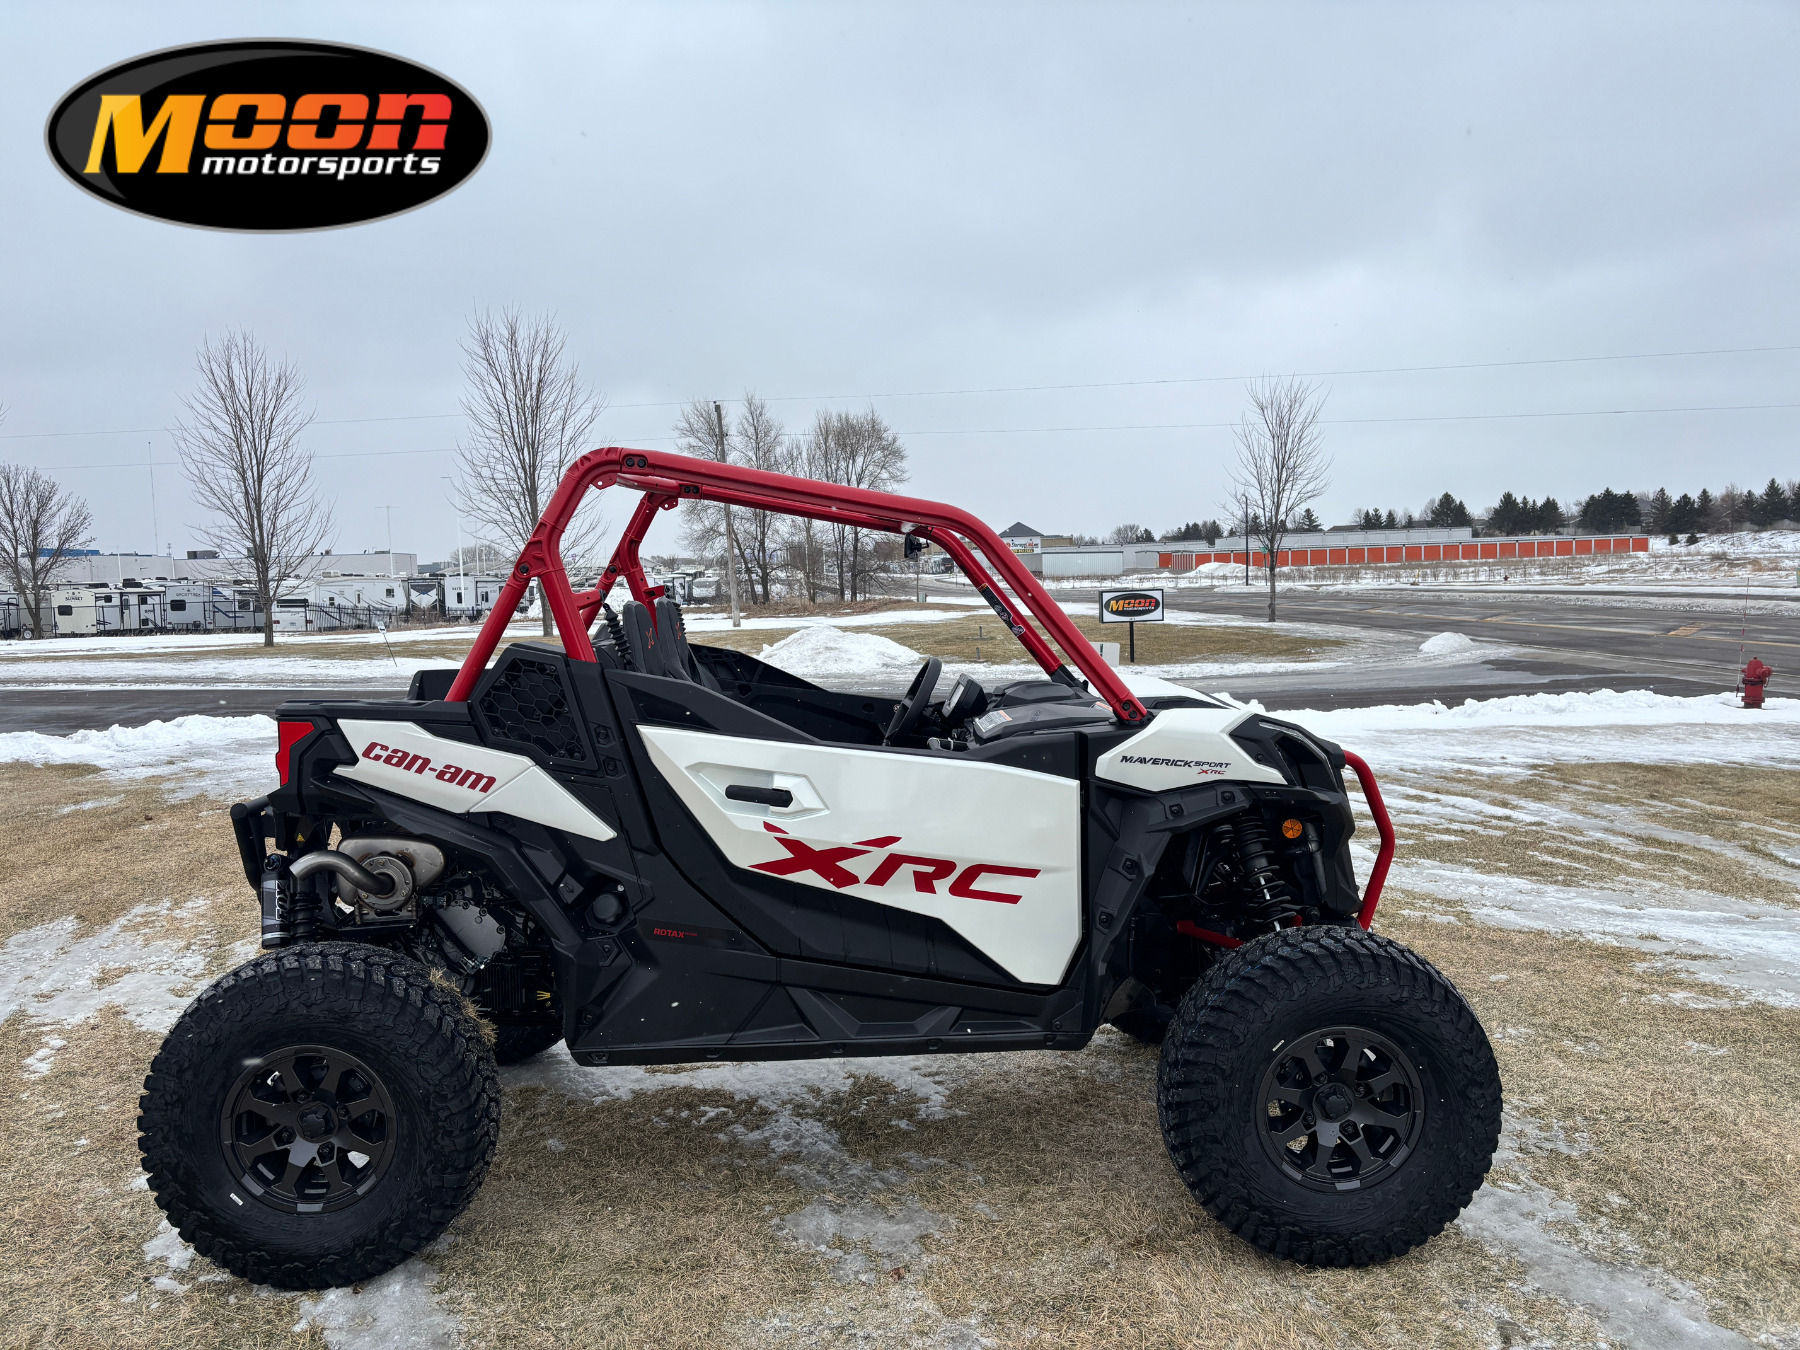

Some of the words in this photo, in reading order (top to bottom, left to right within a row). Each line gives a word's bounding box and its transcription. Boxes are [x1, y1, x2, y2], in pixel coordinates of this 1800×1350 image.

[1108, 598, 1156, 611] Moon
[361, 741, 497, 794] can-am
[1120, 755, 1193, 768] MAVERICK
[1193, 760, 1231, 769] SPORT
[747, 820, 1042, 905] XRC
[653, 927, 685, 938] ROTAX
